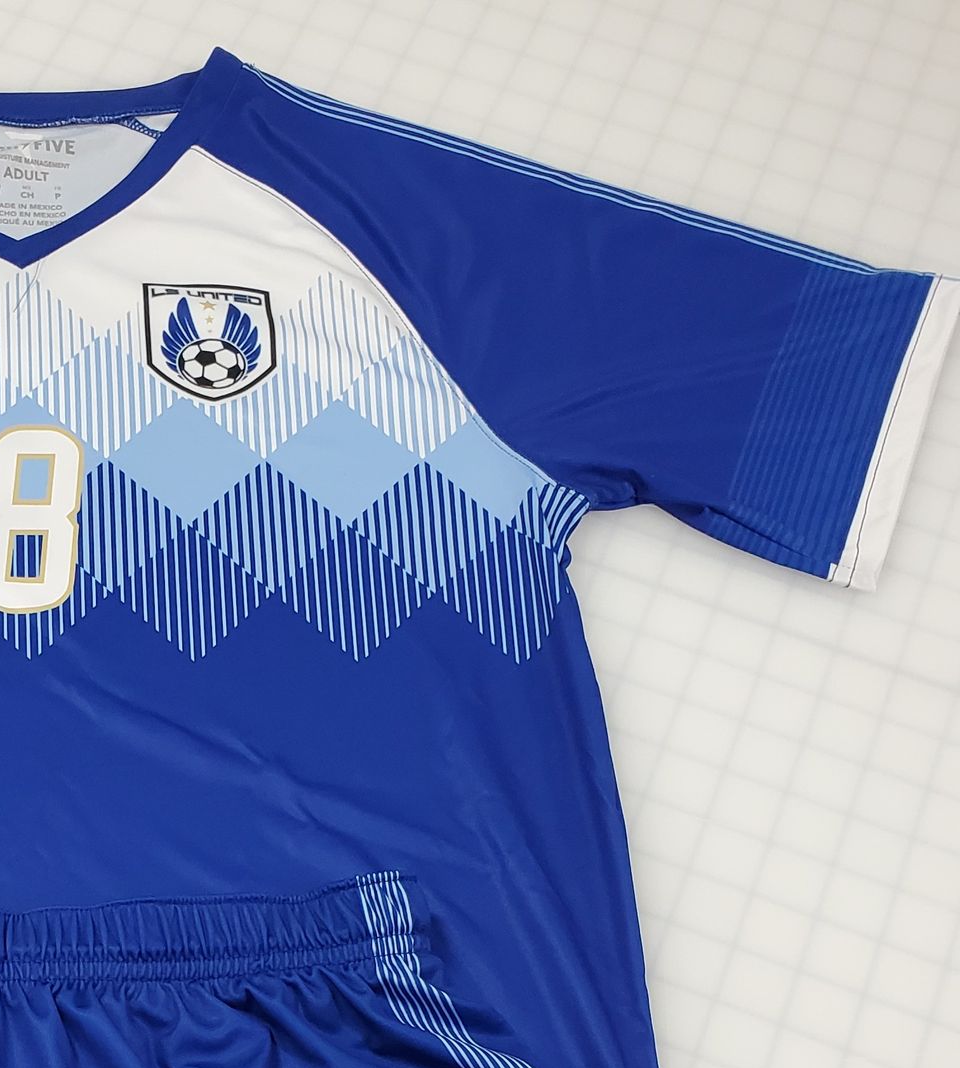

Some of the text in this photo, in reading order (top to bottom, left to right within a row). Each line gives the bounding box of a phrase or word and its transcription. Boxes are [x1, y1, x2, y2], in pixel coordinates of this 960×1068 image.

[34, 139, 75, 155] FIVE
[24, 157, 70, 169] MANAGEMENT
[3, 166, 49, 182] ADULT
[20, 191, 34, 199] CH
[151, 287, 262, 306] LS UNITED
